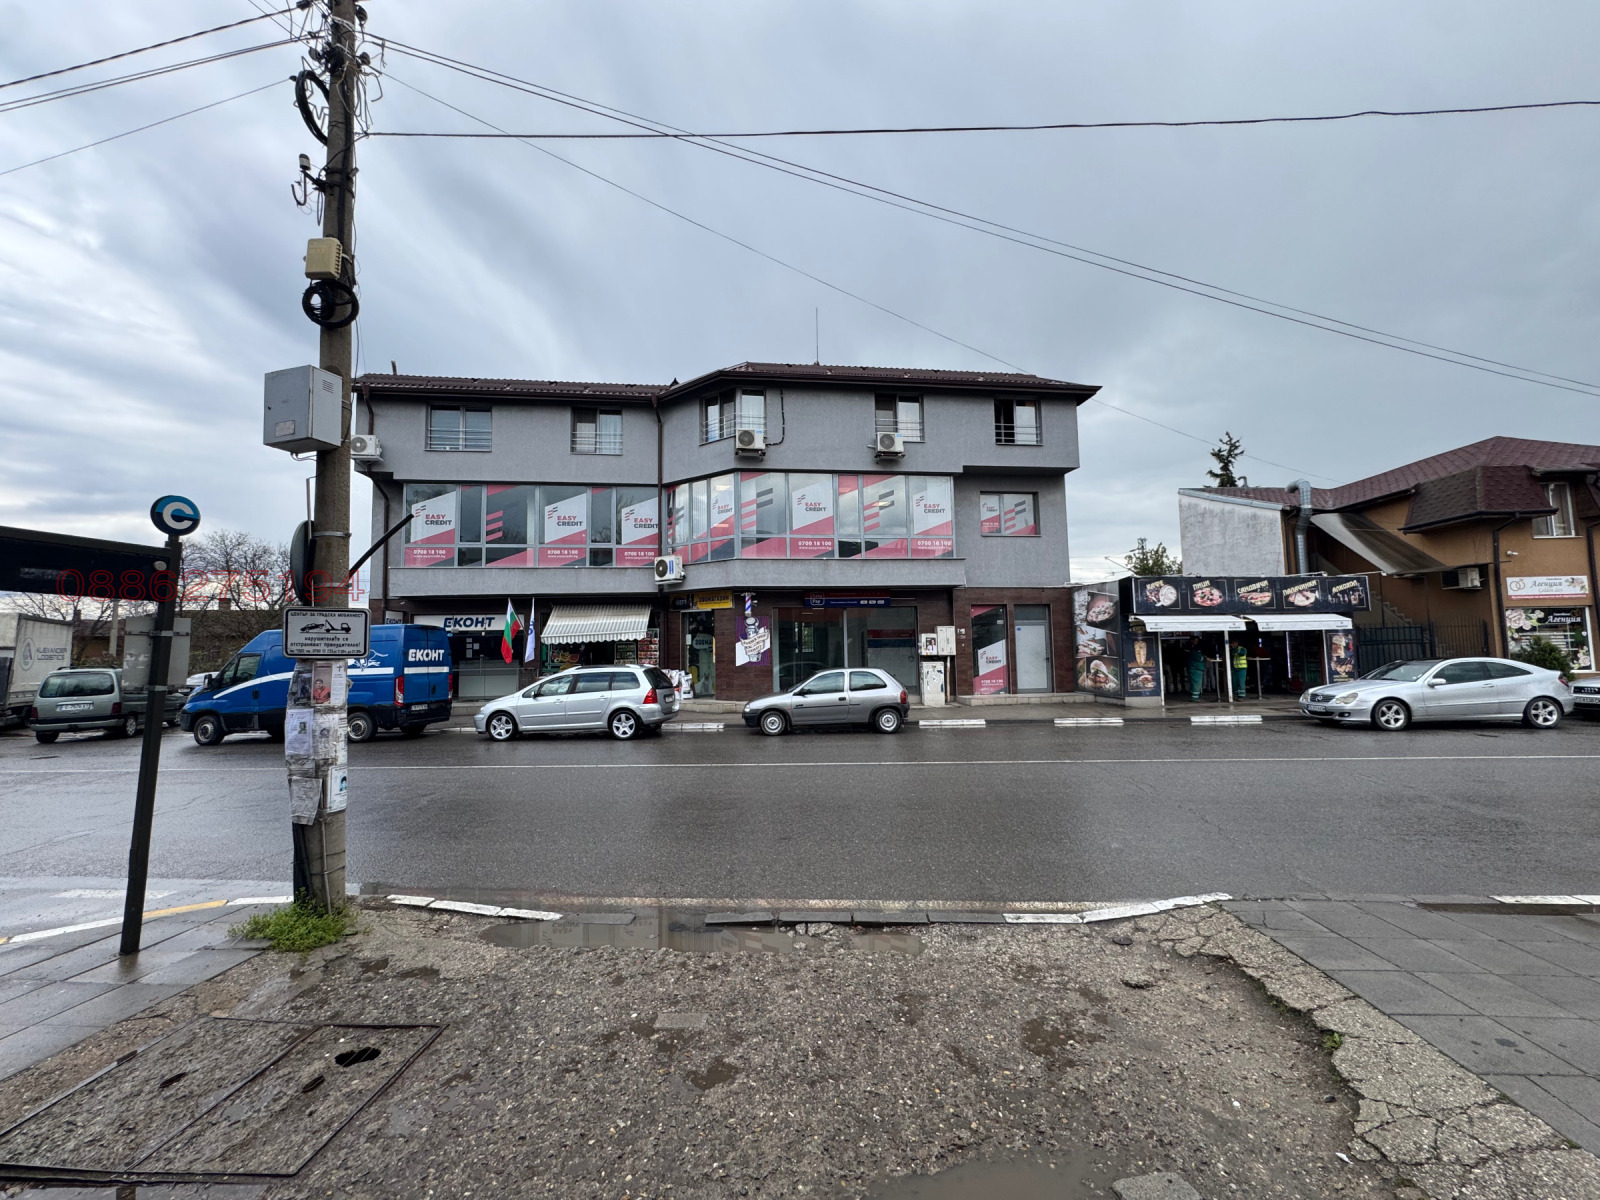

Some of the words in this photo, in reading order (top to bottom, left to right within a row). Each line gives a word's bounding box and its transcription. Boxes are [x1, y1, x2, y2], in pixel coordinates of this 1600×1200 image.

[1146, 580, 1164, 590] КАФЕ
[1192, 580, 1210, 590] ПИЦИ
[1237, 580, 1269, 594] САНДВИЧИ
[1282, 580, 1317, 596] ПАЛАЧИНКИ
[1332, 580, 1358, 593] АЛКОХОЛ
[444, 617, 495, 628] ЕКОНТ
[1546, 616, 1581, 624] Агенция
[408, 649, 444, 661] ЕКОНТ
